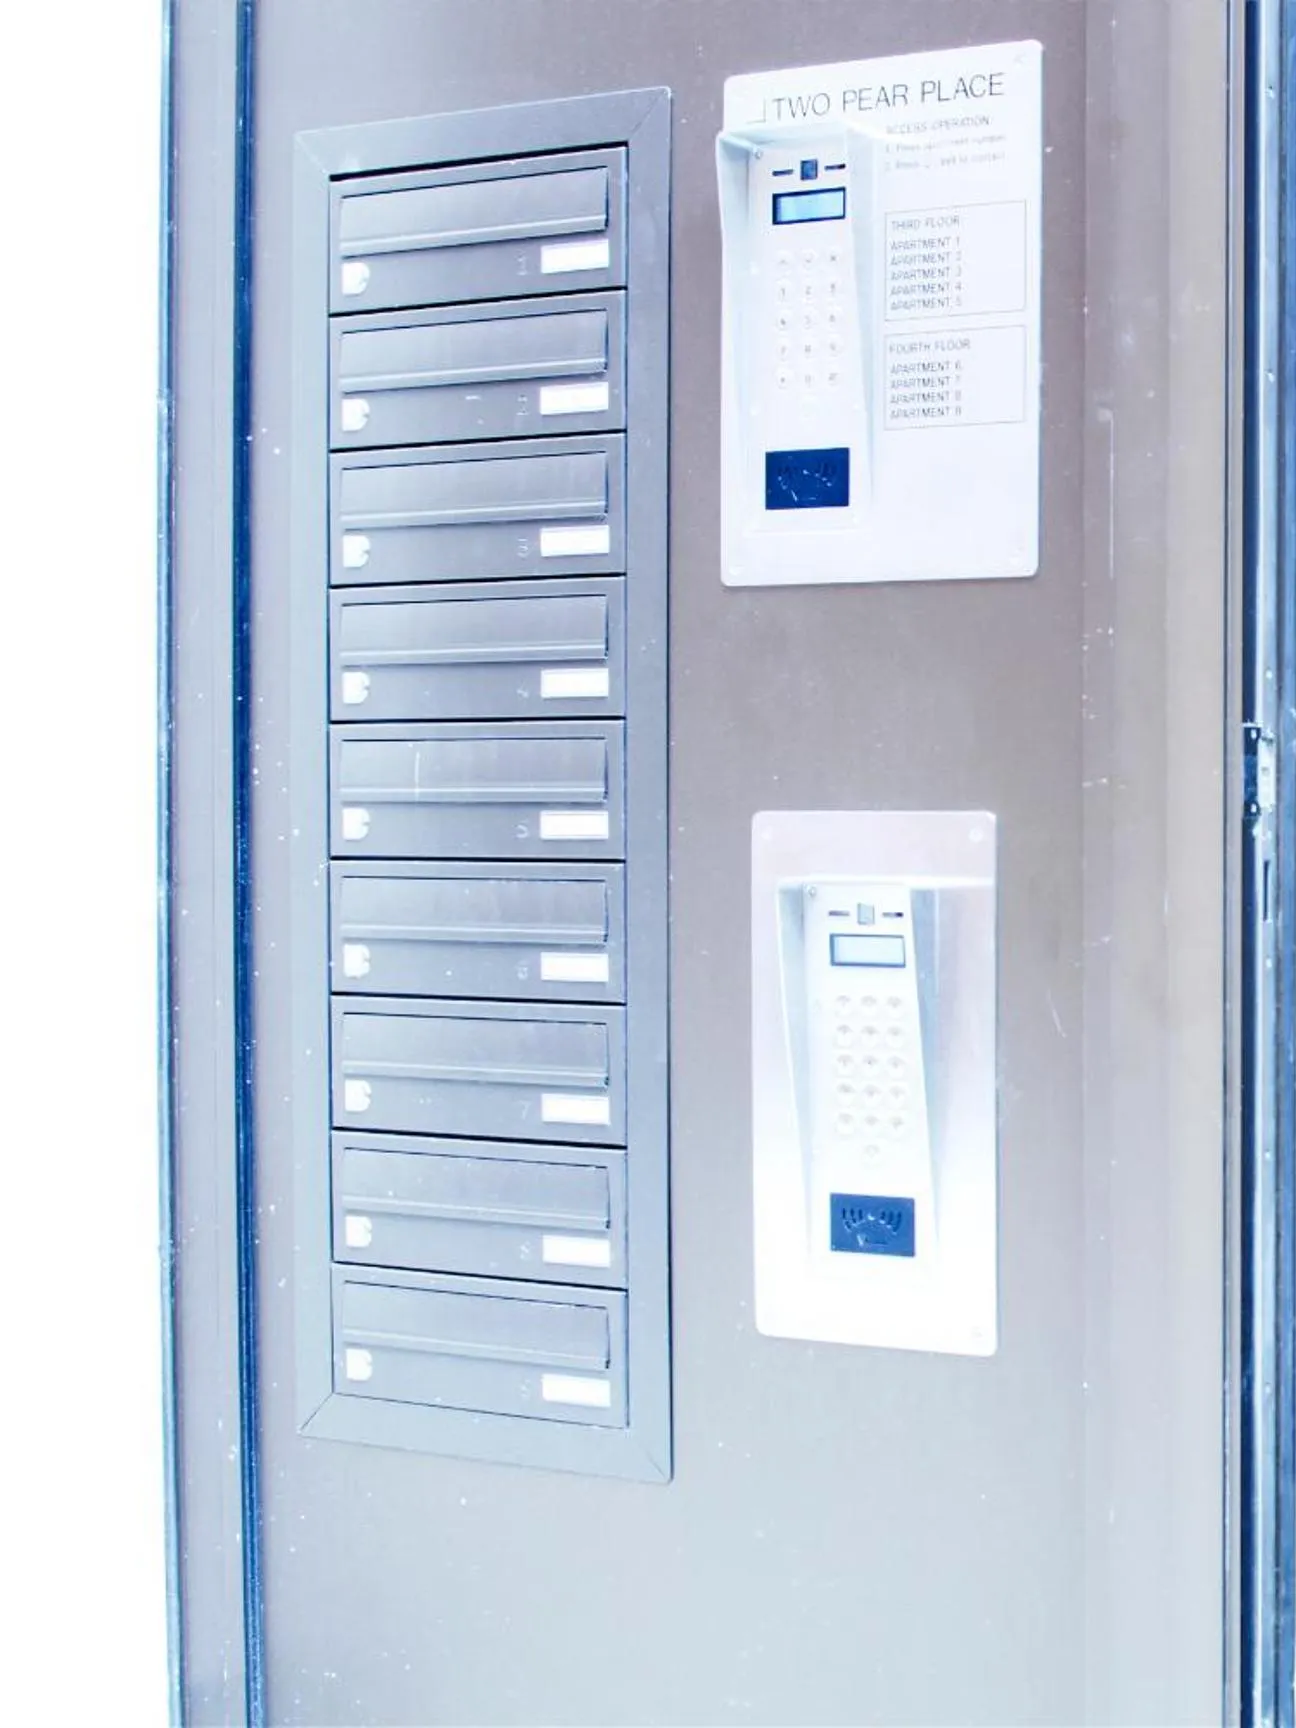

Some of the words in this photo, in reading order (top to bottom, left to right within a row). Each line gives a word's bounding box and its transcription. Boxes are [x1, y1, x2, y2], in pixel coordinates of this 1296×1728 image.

[772, 93, 830, 121] TWO
[842, 83, 908, 112] PEAR
[920, 72, 1005, 102] PLACE
[891, 218, 921, 231] THIRD
[925, 215, 960, 229] FLOOR
[890, 236, 952, 250] APARTMENT
[890, 251, 952, 265] APARTMENT
[890, 266, 952, 280] APARTMENT
[890, 282, 952, 296] APARTMENT
[890, 296, 952, 310] APARTMENT
[889, 342, 931, 355] FOURTH
[934, 338, 971, 351] FLOOR
[890, 360, 951, 374] APARTMENT
[890, 376, 951, 389] APARTMENT
[890, 391, 951, 404] APARTMENT
[890, 406, 951, 420] APARTMENT
